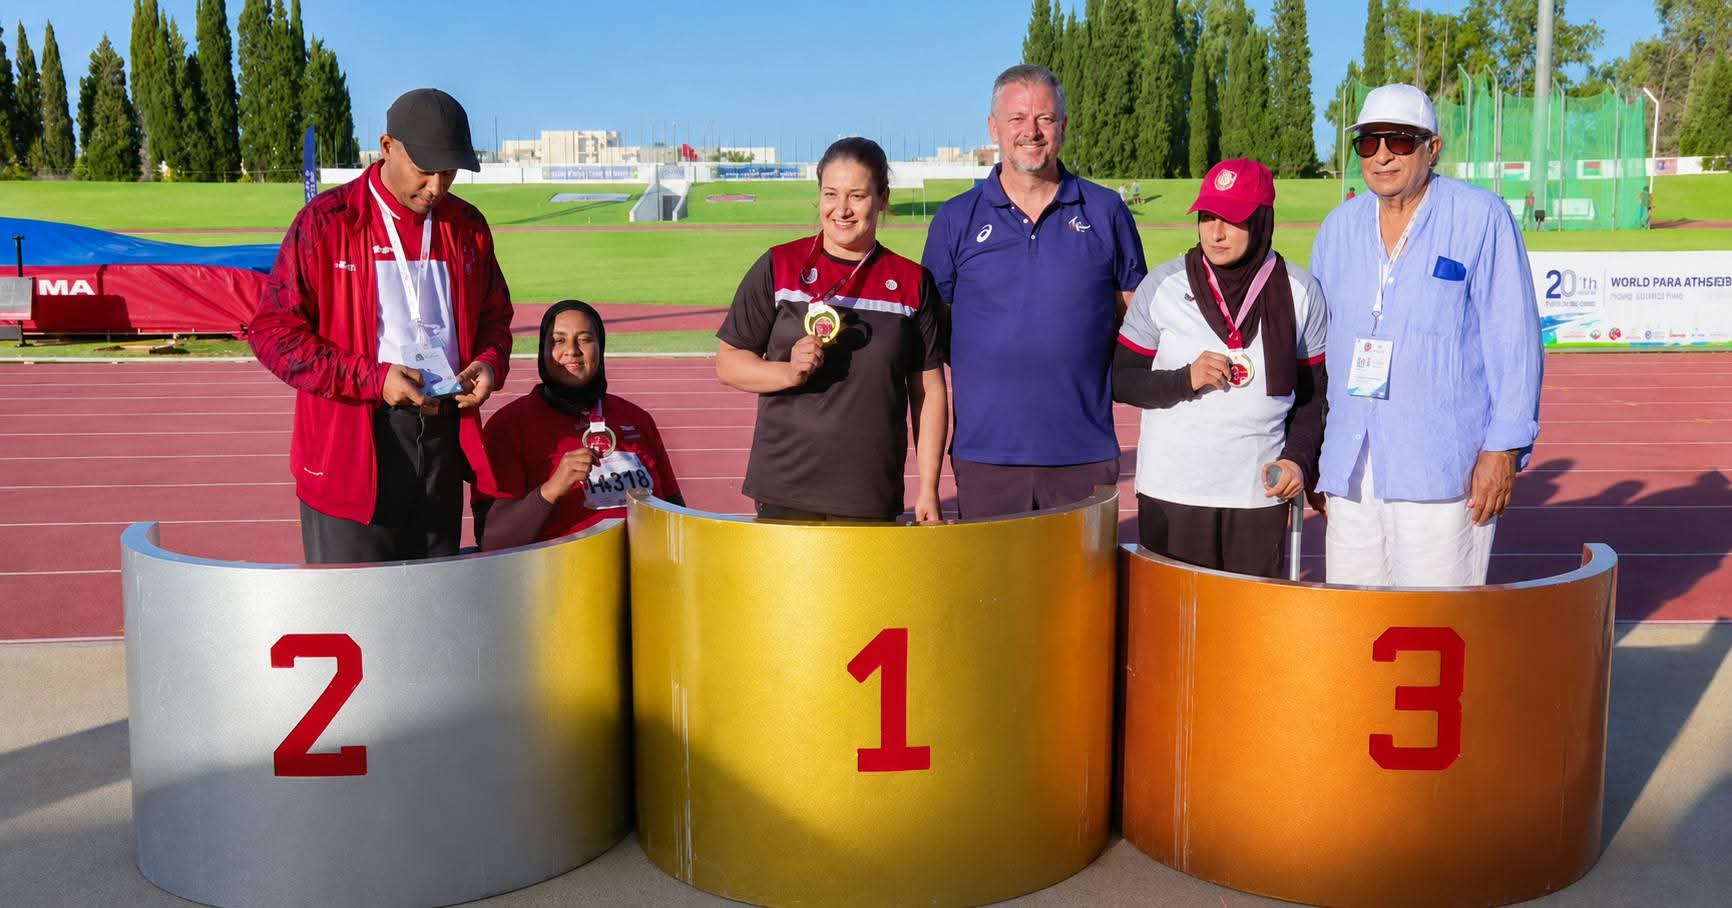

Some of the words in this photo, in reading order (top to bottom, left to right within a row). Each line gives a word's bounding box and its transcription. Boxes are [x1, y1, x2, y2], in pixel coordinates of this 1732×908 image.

[1611, 276, 1650, 288] WORLD
[1653, 276, 1682, 288] PARA
[270, 633, 367, 777] 2
[847, 627, 931, 773] 1
[1369, 626, 1466, 771] 3
